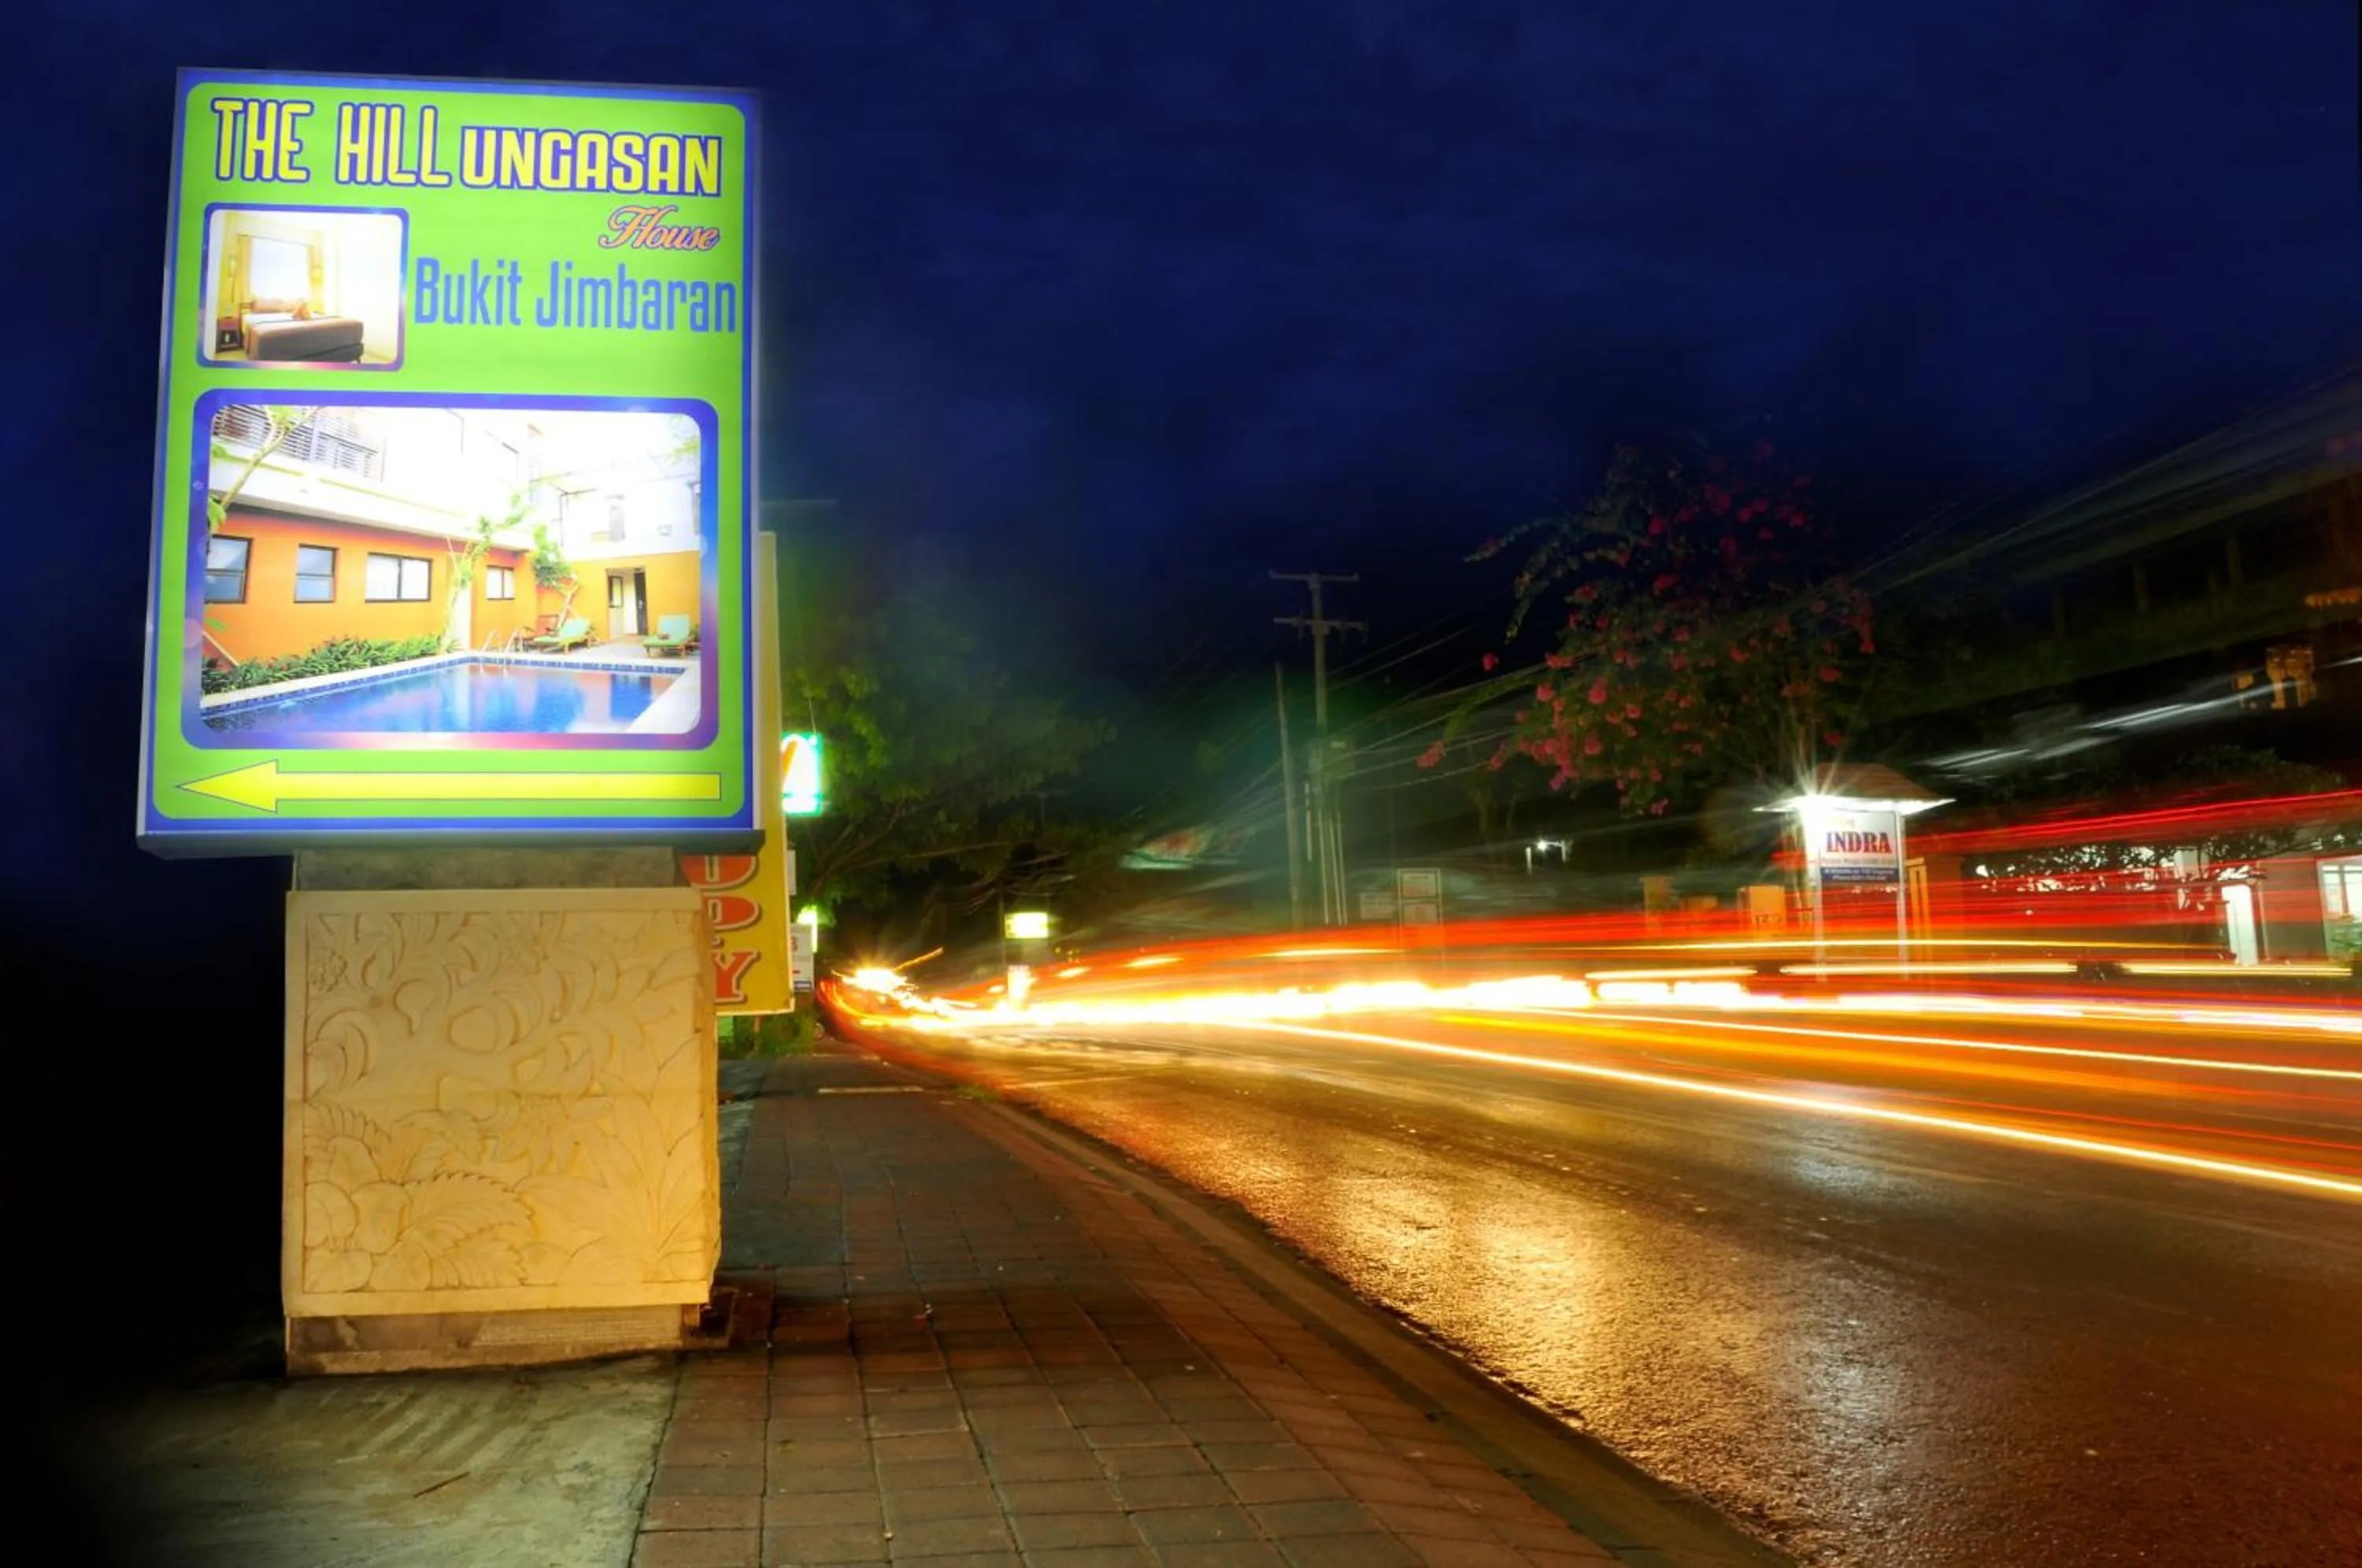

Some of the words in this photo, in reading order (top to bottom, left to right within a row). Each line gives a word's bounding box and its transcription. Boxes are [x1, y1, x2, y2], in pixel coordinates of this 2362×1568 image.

[210, 98, 313, 183] THE
[336, 104, 452, 187] HILL
[460, 125, 721, 197] UNGASAN
[598, 205, 720, 251] House
[414, 257, 523, 325] Bukit
[535, 259, 737, 333] Jimbaran
[1826, 831, 1892, 853] INDRA
